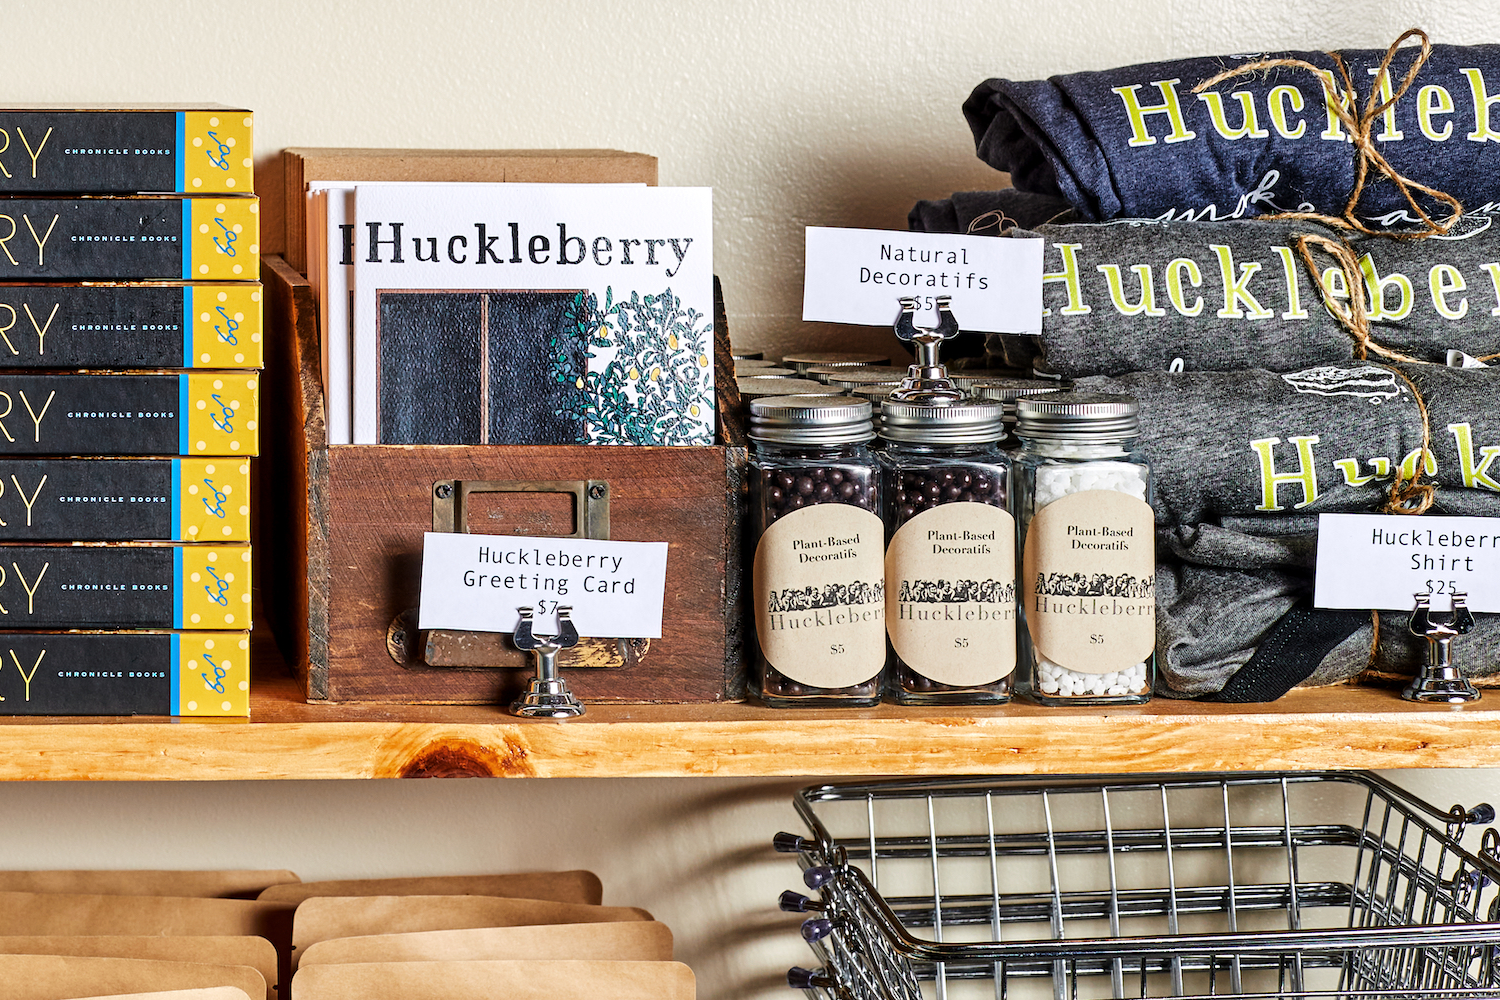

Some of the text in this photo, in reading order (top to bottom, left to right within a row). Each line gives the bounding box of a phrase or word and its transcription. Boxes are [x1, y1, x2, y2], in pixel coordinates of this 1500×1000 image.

[63, 147, 132, 157] CHRONICLE
[134, 147, 172, 157] BOOKS
[364, 221, 694, 279] Huckleberry
[879, 243, 970, 266] Natural
[859, 266, 990, 291] Decoratifs
[792, 533, 861, 551] Plant-Based
[478, 546, 624, 575] Huckleberry
[798, 549, 858, 565] Decoratifs
[1410, 553, 1475, 572] Shirt
[462, 569, 636, 596] Greeting Card
[1425, 579, 1457, 596] $25
[536, 598, 559, 617] $7
[830, 643, 846, 656] $5
